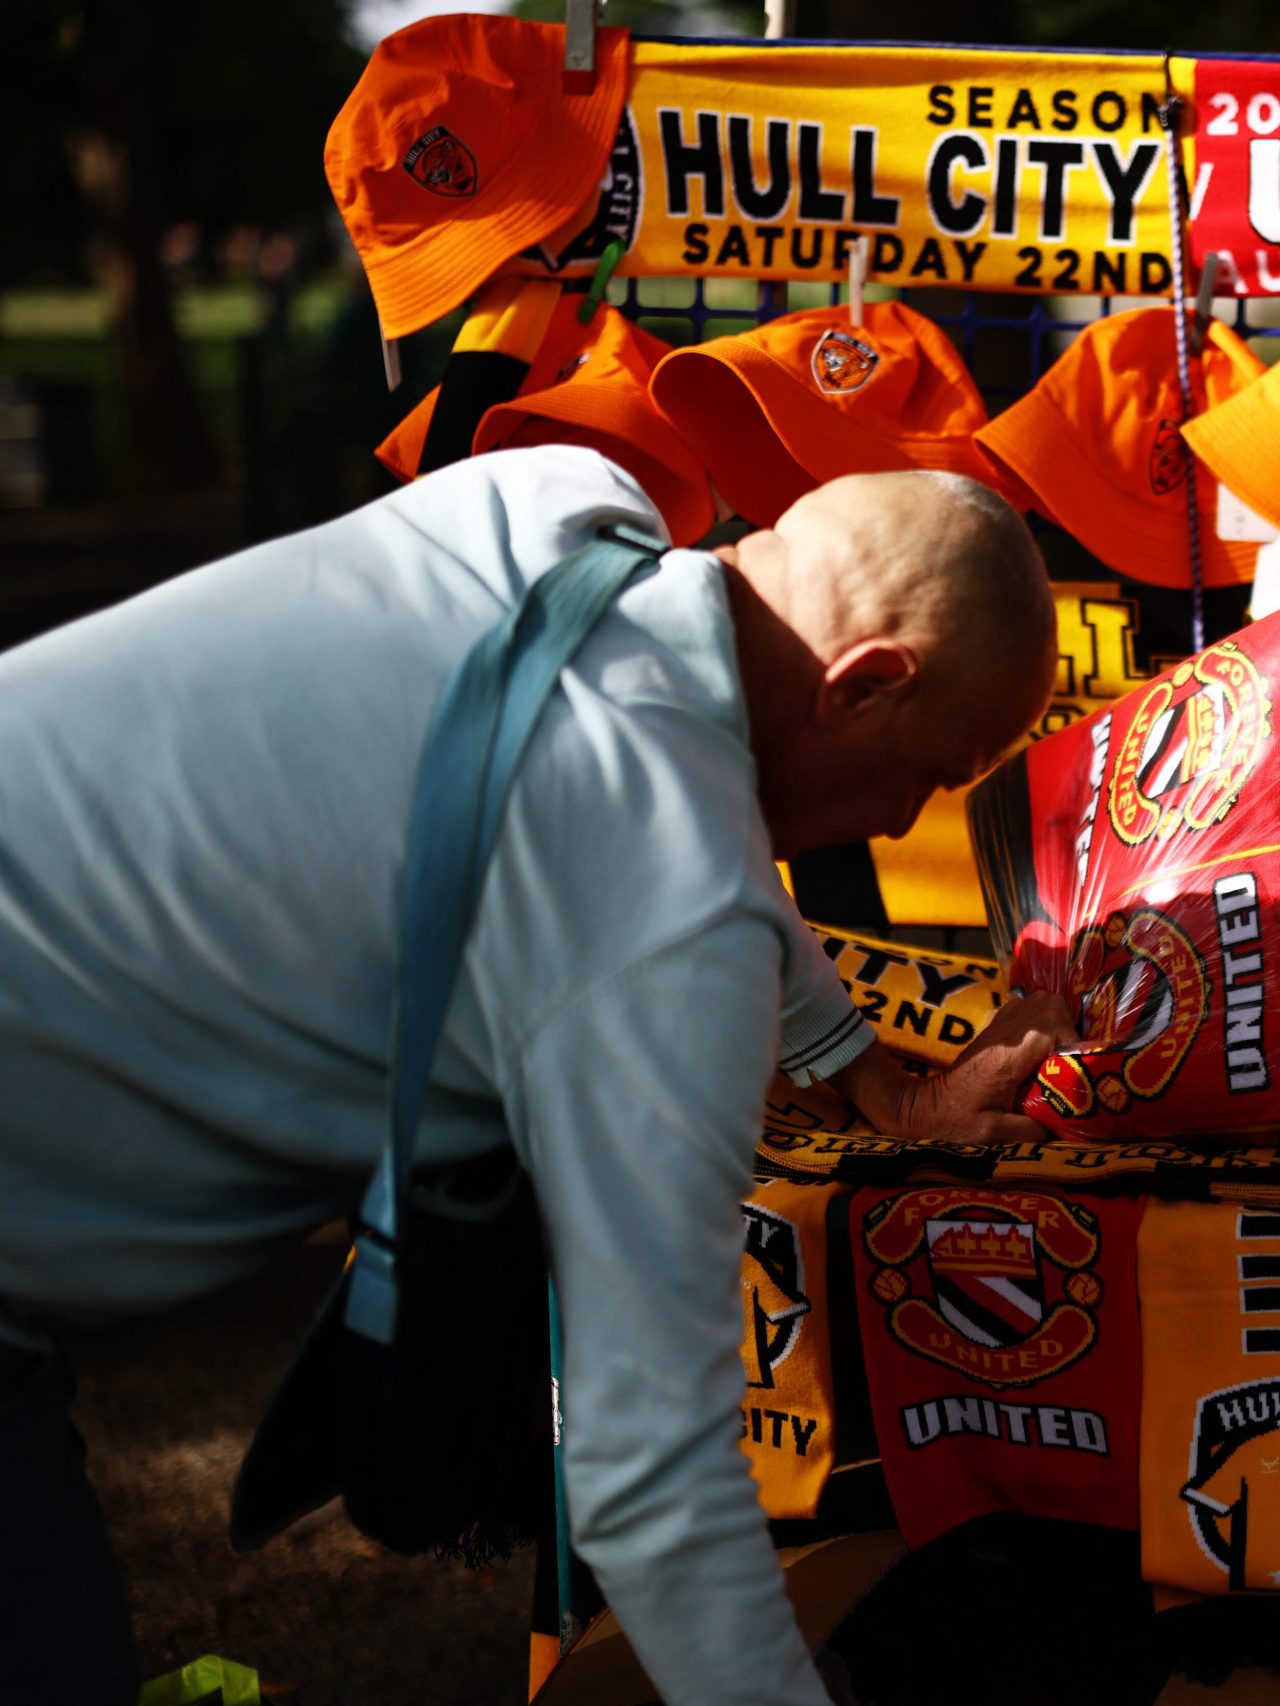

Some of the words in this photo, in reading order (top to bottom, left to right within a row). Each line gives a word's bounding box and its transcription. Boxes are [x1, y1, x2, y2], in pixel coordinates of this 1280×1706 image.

[926, 85, 1172, 133] SEASON
[657, 106, 900, 227] HULL
[926, 131, 1164, 247] CITY
[682, 223, 988, 282] SATURDAY
[1015, 248, 1173, 293] 22ND
[1117, 713, 1151, 827] UNITED
[842, 979, 975, 1045] 2ND
[1154, 933, 1195, 1061] UNITED
[1212, 872, 1270, 1094] UNITED
[928, 1332, 1064, 1372] UNITED
[739, 1406, 817, 1457] ITY
[902, 1397, 1109, 1456] UNITED
